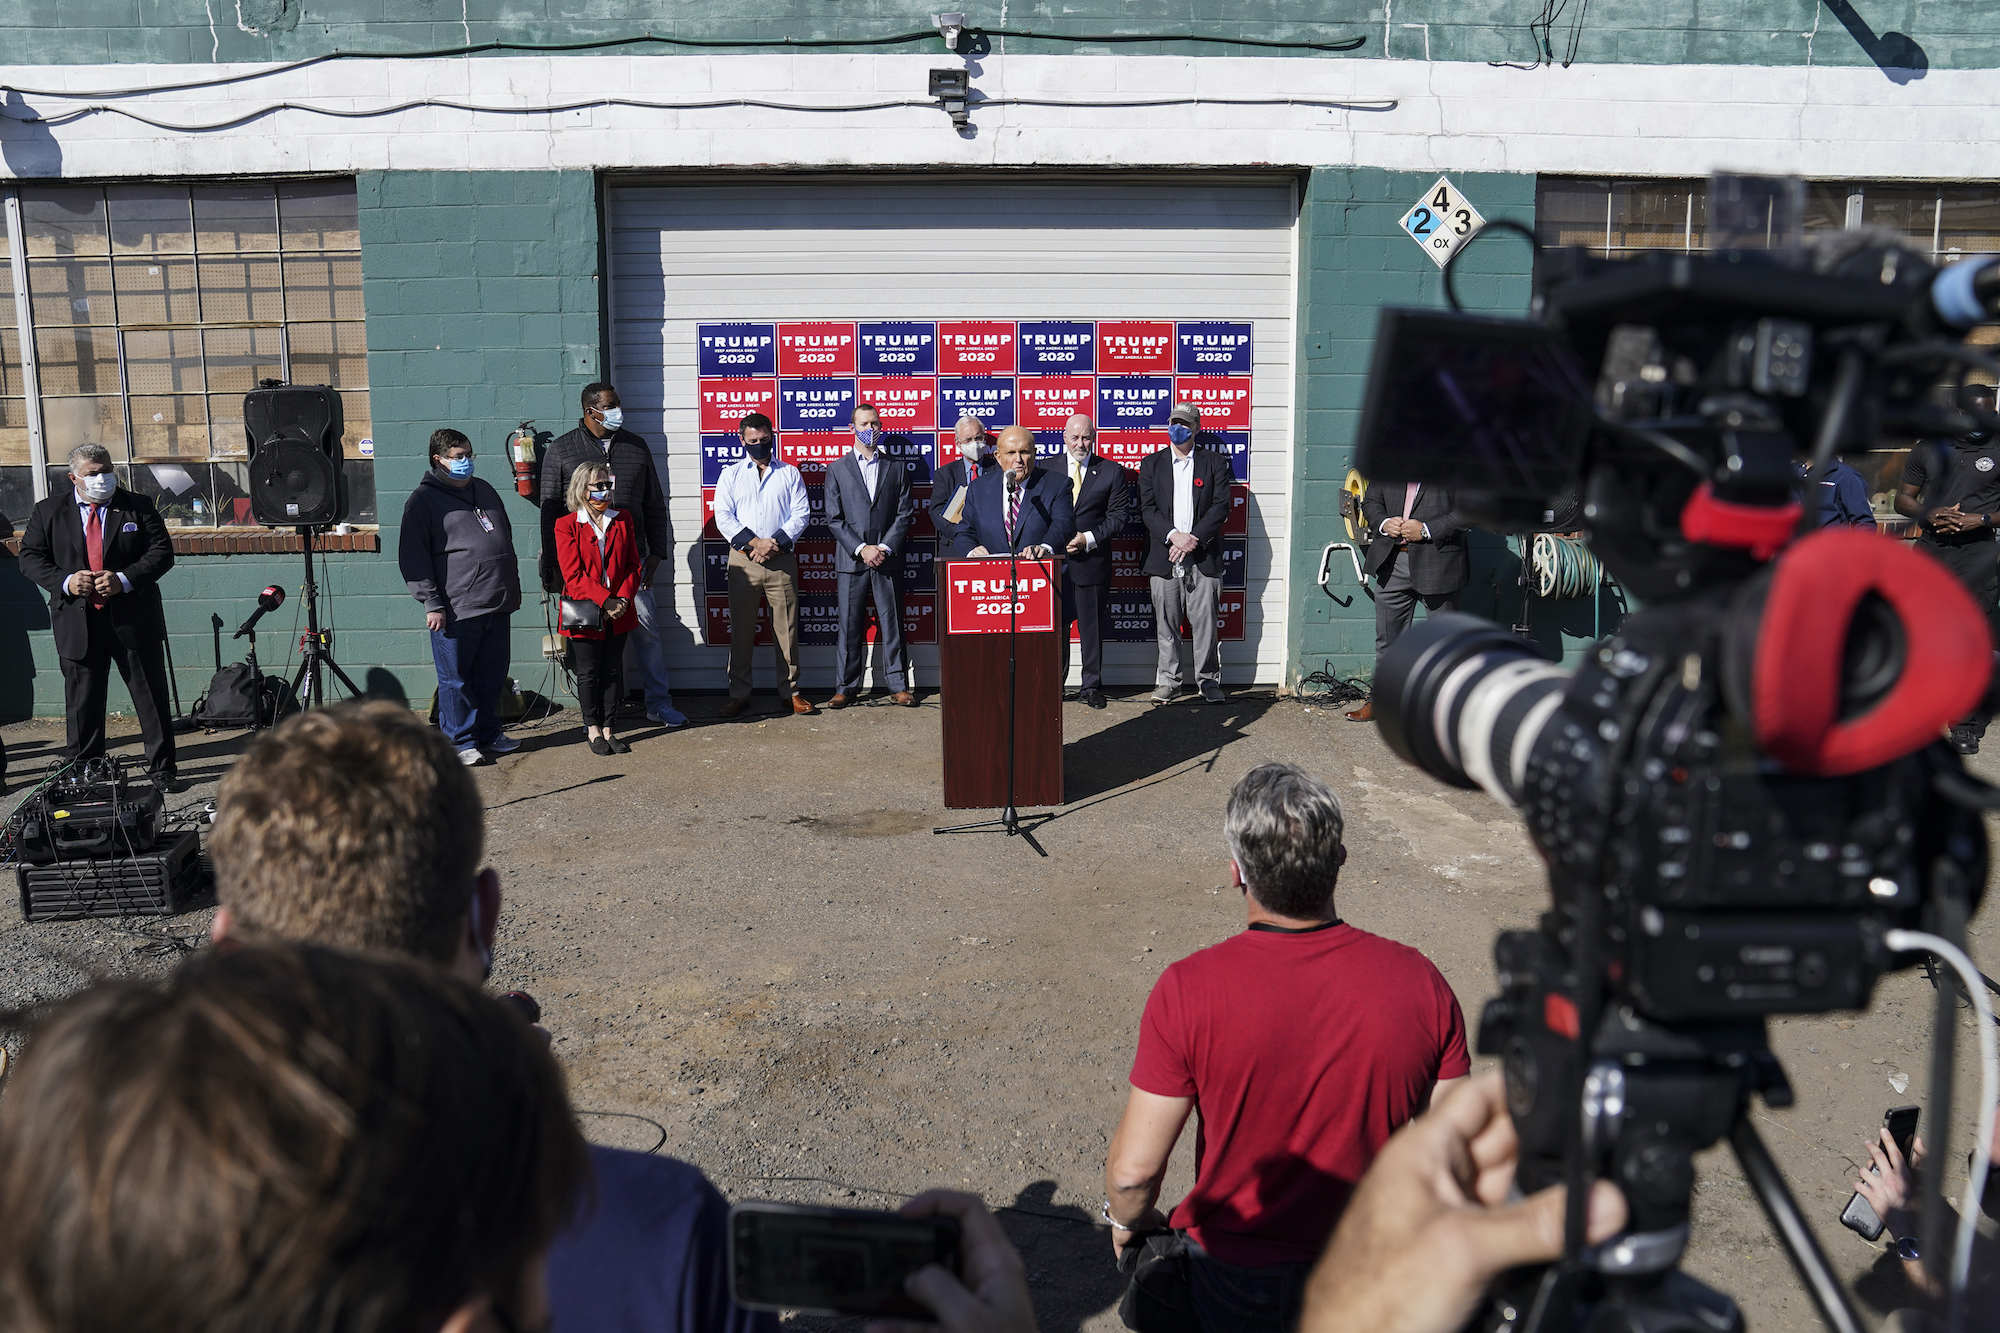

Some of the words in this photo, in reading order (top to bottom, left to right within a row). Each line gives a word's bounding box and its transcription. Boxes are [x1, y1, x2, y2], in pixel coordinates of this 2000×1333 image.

[1432, 186, 1450, 213] 4
[1413, 208, 1431, 234] 2
[1455, 209, 1472, 236] 3
[1433, 238, 1450, 249] OX
[702, 336, 771, 347] TRUMP
[782, 335, 851, 346] TRUMP
[862, 335, 931, 346] TRUMP
[942, 335, 1011, 345] TRUMP
[1022, 334, 1091, 345] TRUMP
[1103, 336, 1169, 346] TRUMP
[1180, 335, 1248, 345] TRUMP
[718, 354, 755, 363] 2020
[798, 353, 835, 363] 2020
[879, 353, 915, 362] 2020
[958, 352, 995, 362] 2020
[1038, 352, 1075, 362] 2020
[1196, 353, 1232, 362] 2020
[704, 392, 773, 402] TRUMP
[783, 391, 852, 401] TRUMP
[863, 390, 932, 400] TRUMP
[942, 390, 1011, 400] TRUMP
[1022, 389, 1091, 400] TRUMP
[1101, 389, 1169, 400] TRUMP
[1179, 389, 1247, 400] TRUMP
[800, 409, 836, 418] 2020
[879, 408, 916, 417] 2020
[959, 407, 995, 416] 2020
[1038, 407, 1075, 416] 2020
[1117, 407, 1153, 416] 2020
[1198, 407, 1231, 416] 2020
[704, 446, 743, 457] TRU
[784, 445, 853, 456] TRUMP
[877, 444, 932, 455] RUMP
[801, 462, 827, 472] 202
[799, 553, 835, 563] RUM
[803, 570, 837, 580] 2020
[954, 578, 1047, 594] TRUMP
[800, 606, 839, 617] RUM
[976, 602, 1025, 615] 2020
[1111, 603, 1152, 614] RUM
[804, 623, 839, 632] 2020
[1114, 620, 1150, 630] 2020
